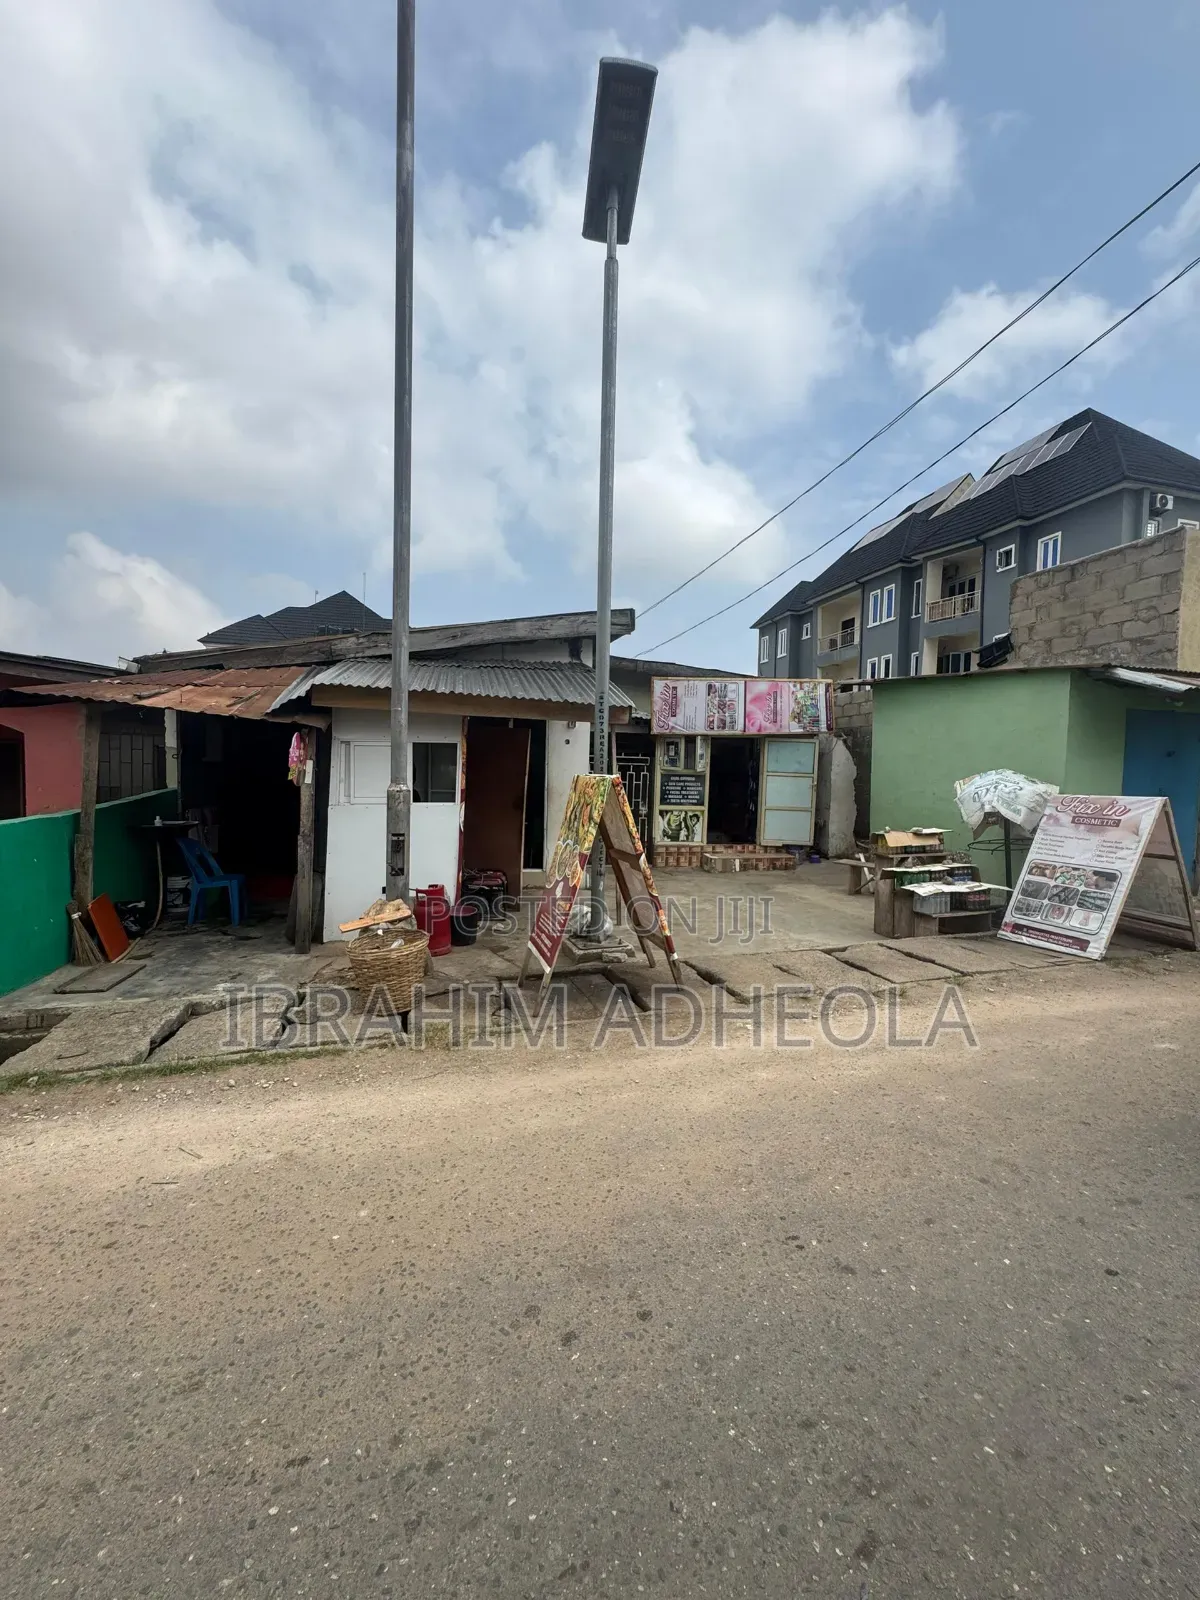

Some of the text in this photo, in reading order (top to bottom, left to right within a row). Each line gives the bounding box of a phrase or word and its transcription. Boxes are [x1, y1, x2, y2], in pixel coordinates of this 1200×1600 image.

[1056, 796, 1131, 817] Fix in
[1074, 817, 1118, 827] COSMETIC
